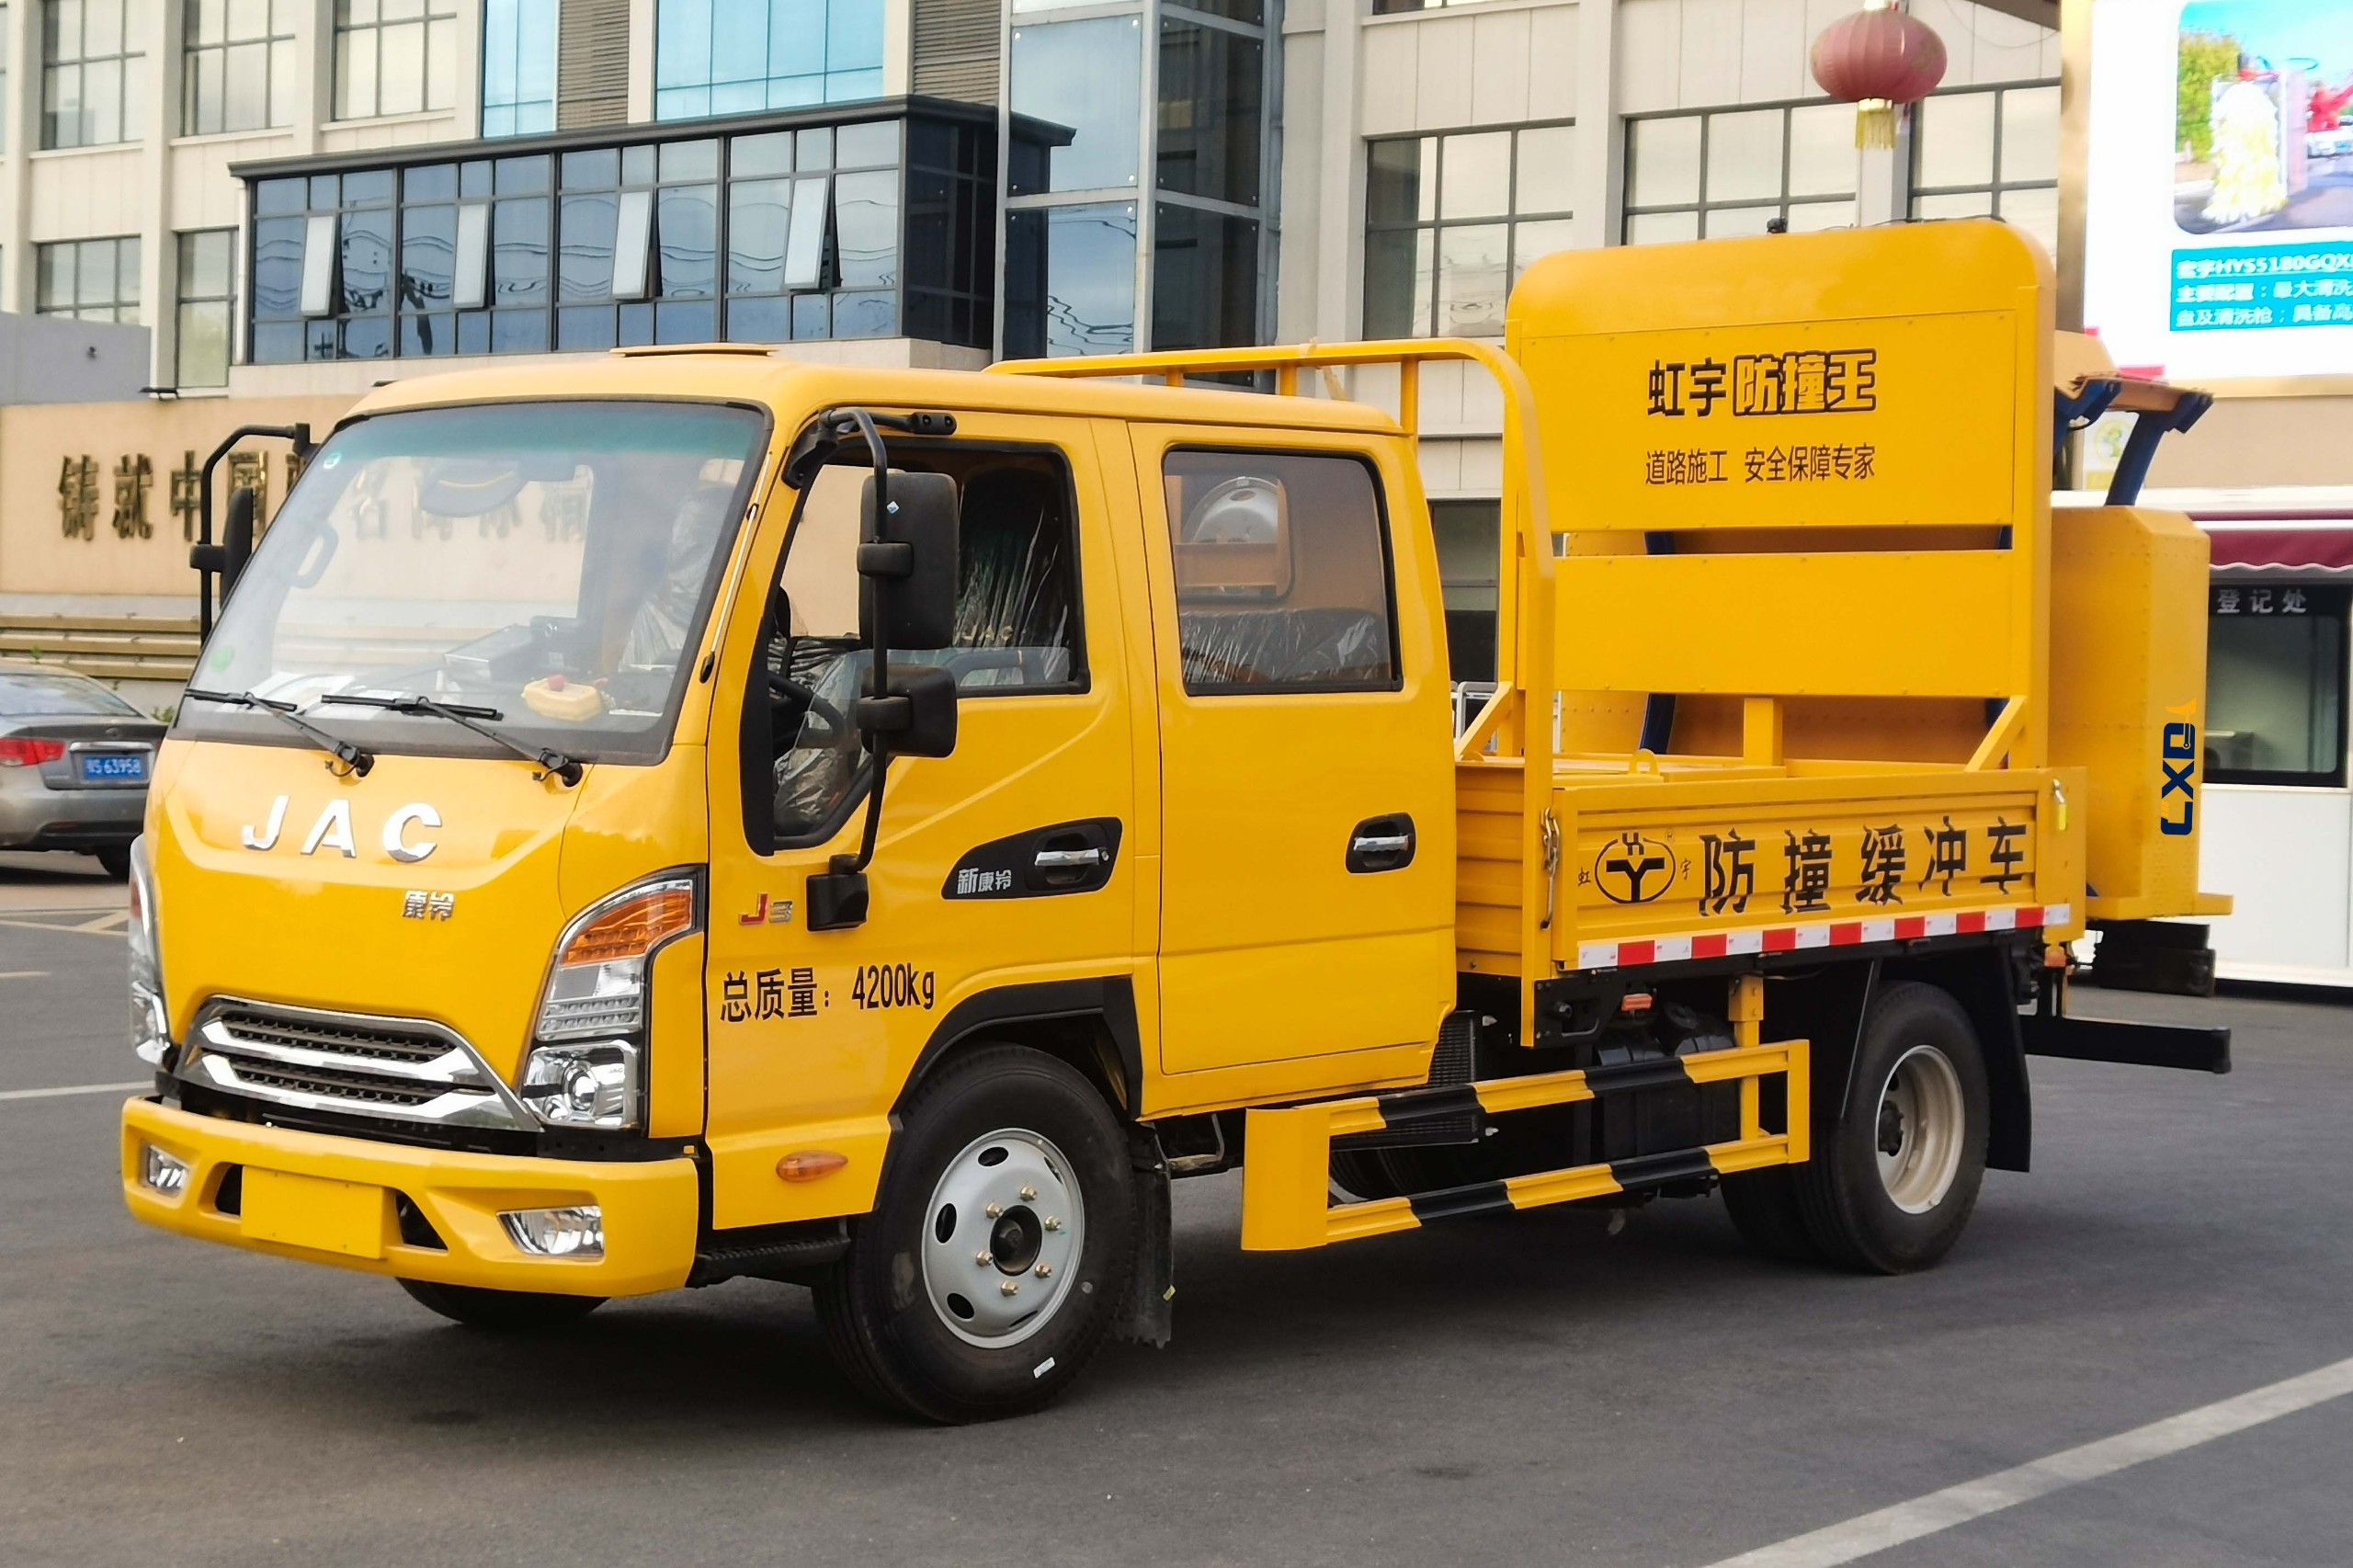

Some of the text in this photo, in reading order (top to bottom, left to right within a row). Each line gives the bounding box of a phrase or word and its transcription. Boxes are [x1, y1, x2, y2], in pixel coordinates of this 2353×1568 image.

[1646, 348, 1877, 418] 虹宇防撞王
[1645, 442, 1876, 486] 道路施工 安全保障专家
[2217, 589, 2307, 614] 登记处
[241, 794, 443, 864] JAC
[957, 868, 1012, 895] 新康铃
[1577, 867, 1591, 887] 虹
[1698, 815, 2027, 916] 防撞缓冲车
[720, 962, 935, 1023] 总质量： 4200kg
